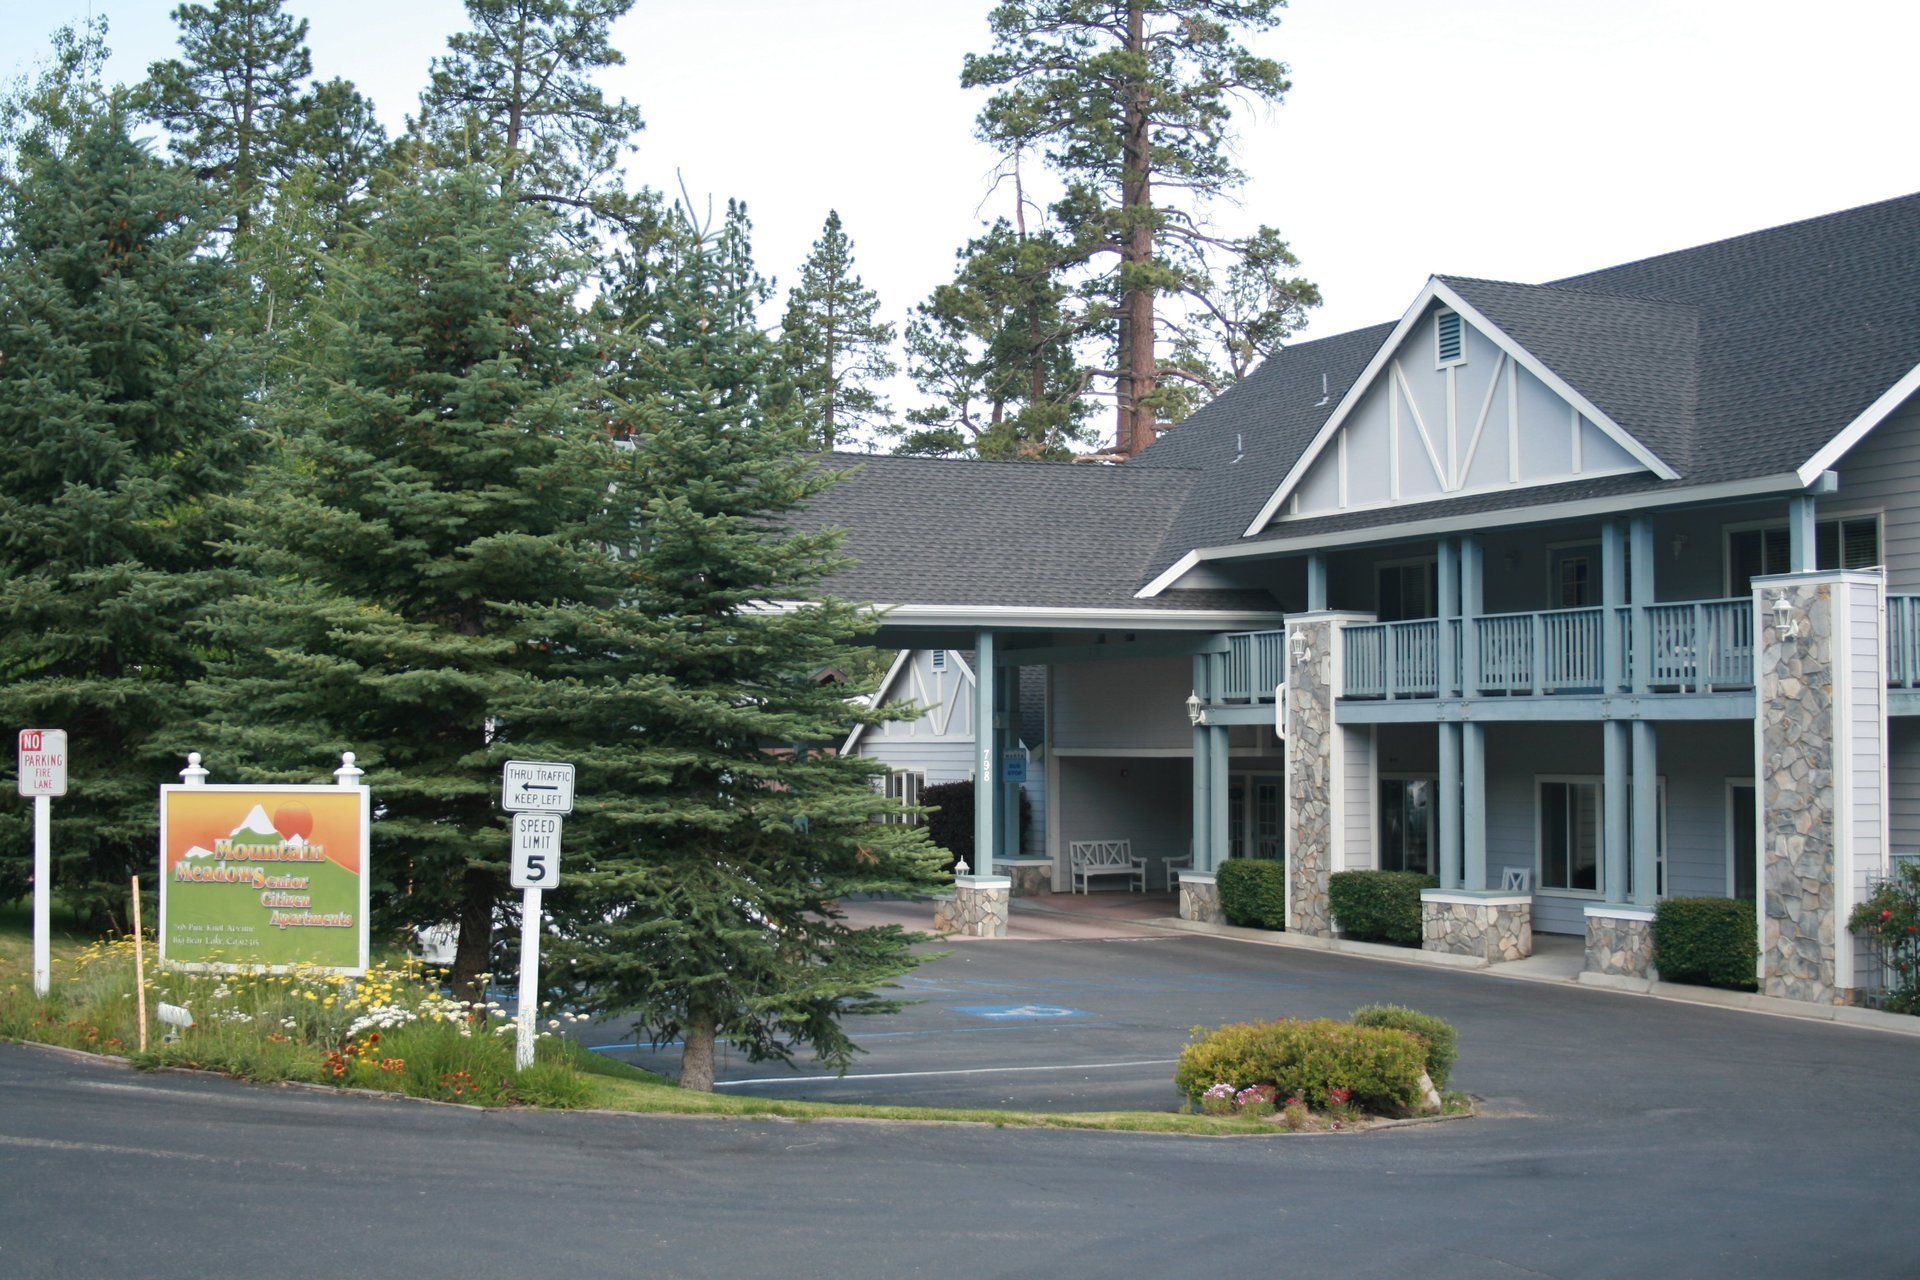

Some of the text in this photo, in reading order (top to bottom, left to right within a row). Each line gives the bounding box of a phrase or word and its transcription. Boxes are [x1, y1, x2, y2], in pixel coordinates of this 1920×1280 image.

[24, 734, 40, 749] NO
[24, 754, 63, 767] PARKING
[35, 768, 52, 778] FIRE
[509, 768, 571, 783] THRU TRAFFIC
[33, 779, 53, 789] LANE
[515, 793, 562, 805] KEEP LEFT
[520, 819, 555, 833] SPEED
[522, 835, 551, 849] LIMIT
[214, 838, 326, 862] Mountain
[526, 854, 547, 881] 5
[260, 891, 312, 908] Citizen
[269, 909, 354, 930] Apartments
